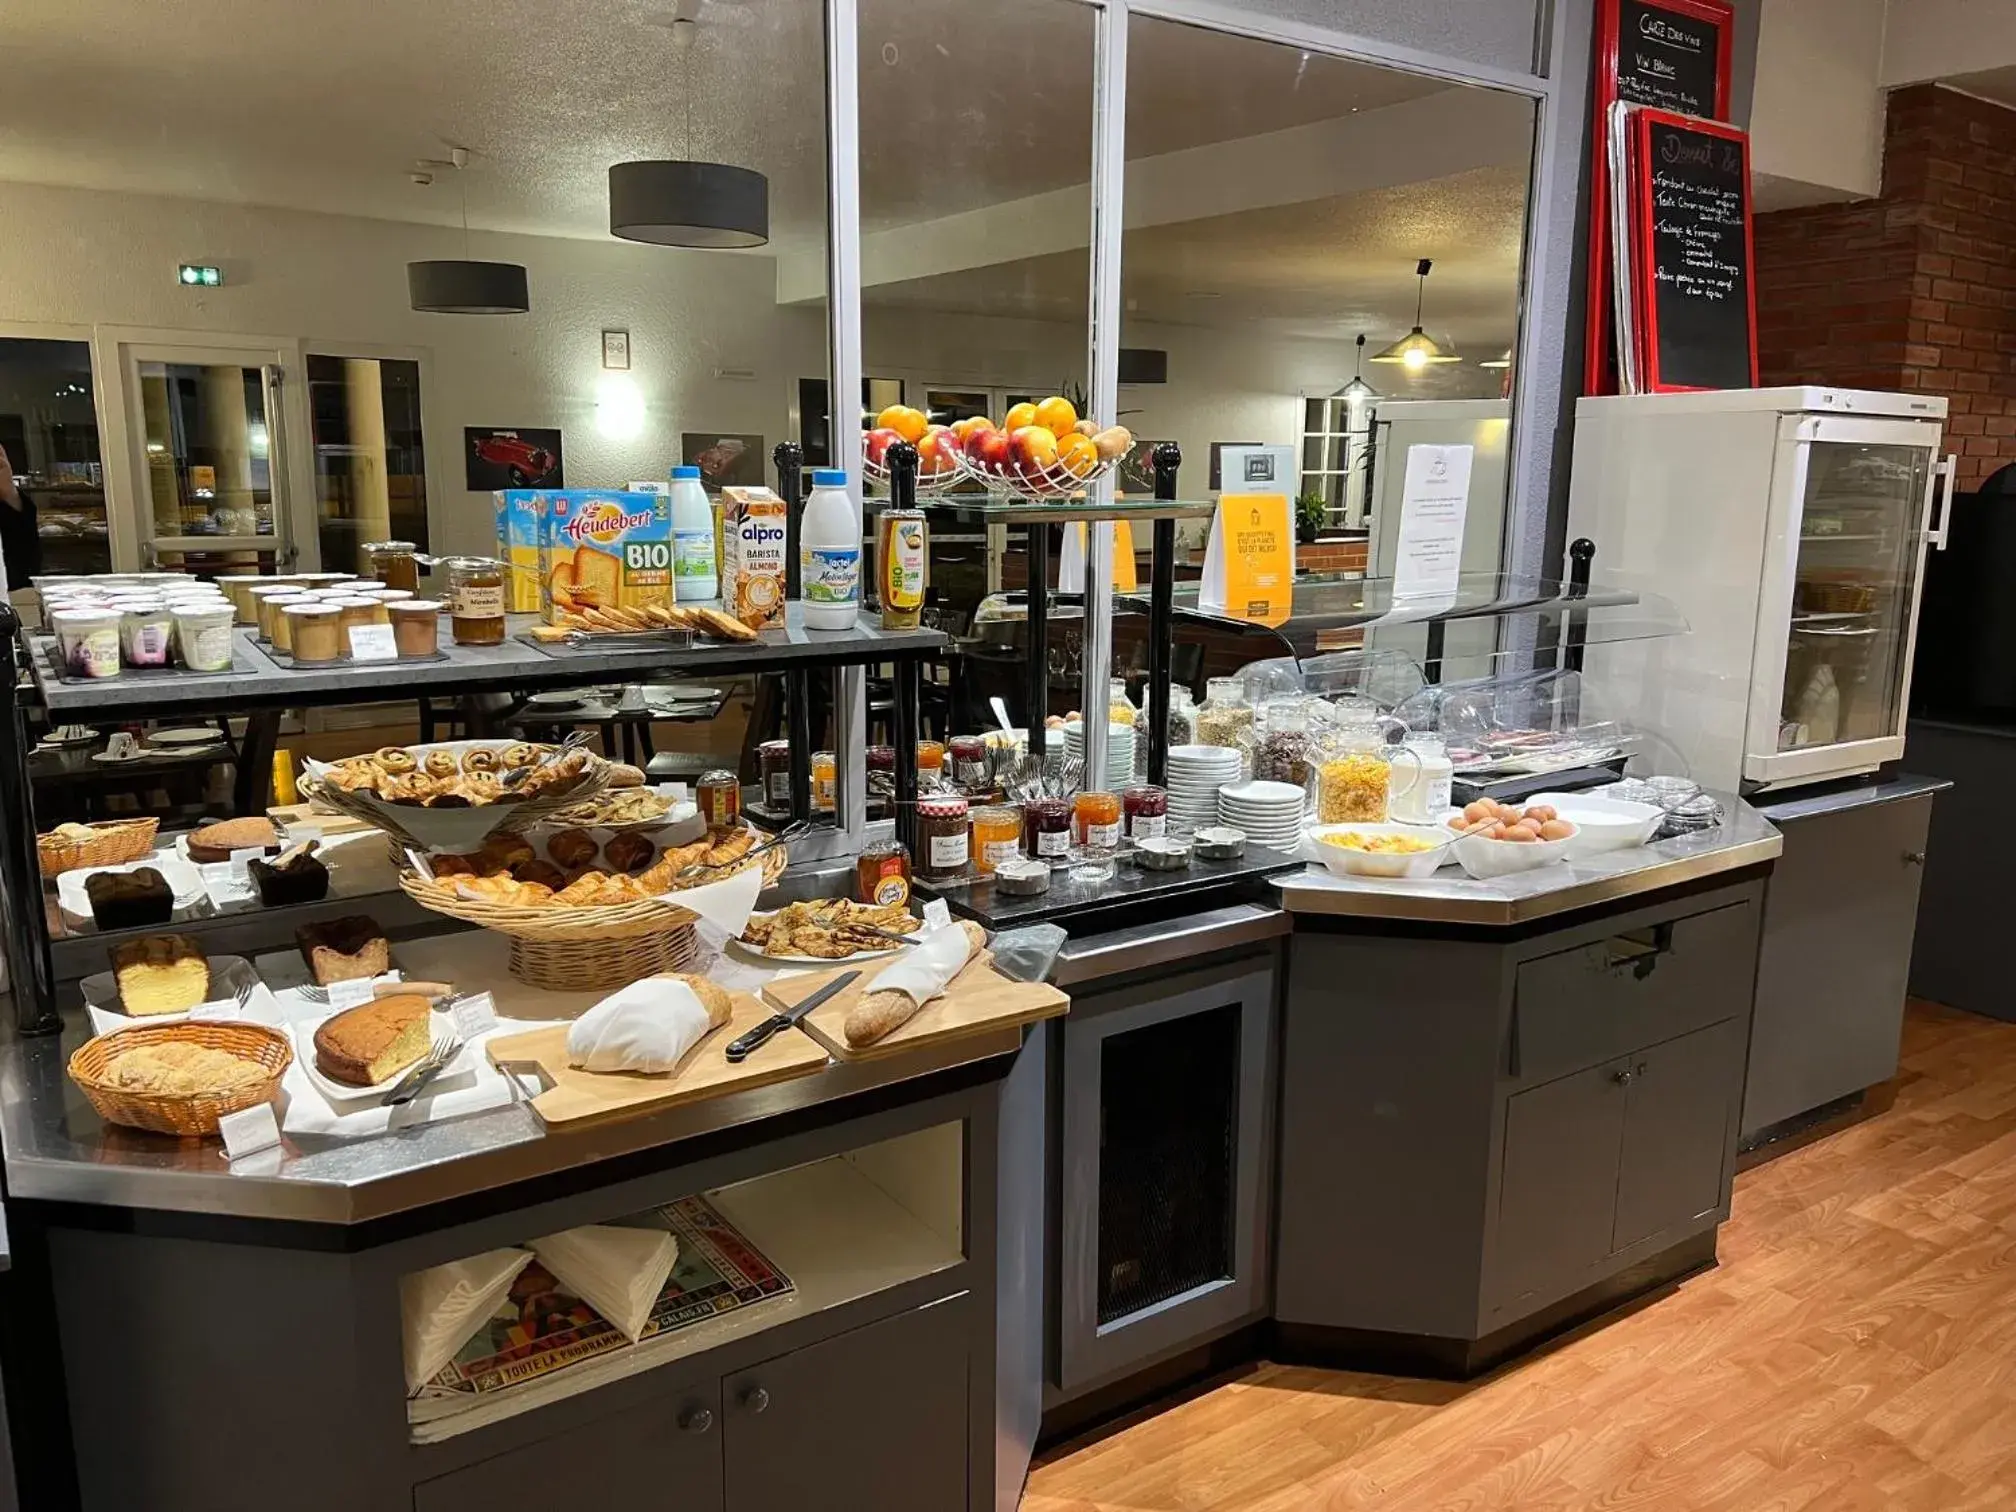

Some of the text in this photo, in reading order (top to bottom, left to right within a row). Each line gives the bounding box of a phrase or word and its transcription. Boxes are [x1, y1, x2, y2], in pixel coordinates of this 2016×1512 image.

[562, 509, 652, 540] Heudebert
[742, 524, 784, 544] alpro
[627, 543, 669, 569] BIO
[746, 549, 780, 559] BARISTA
[749, 561, 778, 570] ALMOND
[505, 1359, 542, 1379] TOUTE
[543, 1353, 559, 1370] LA
